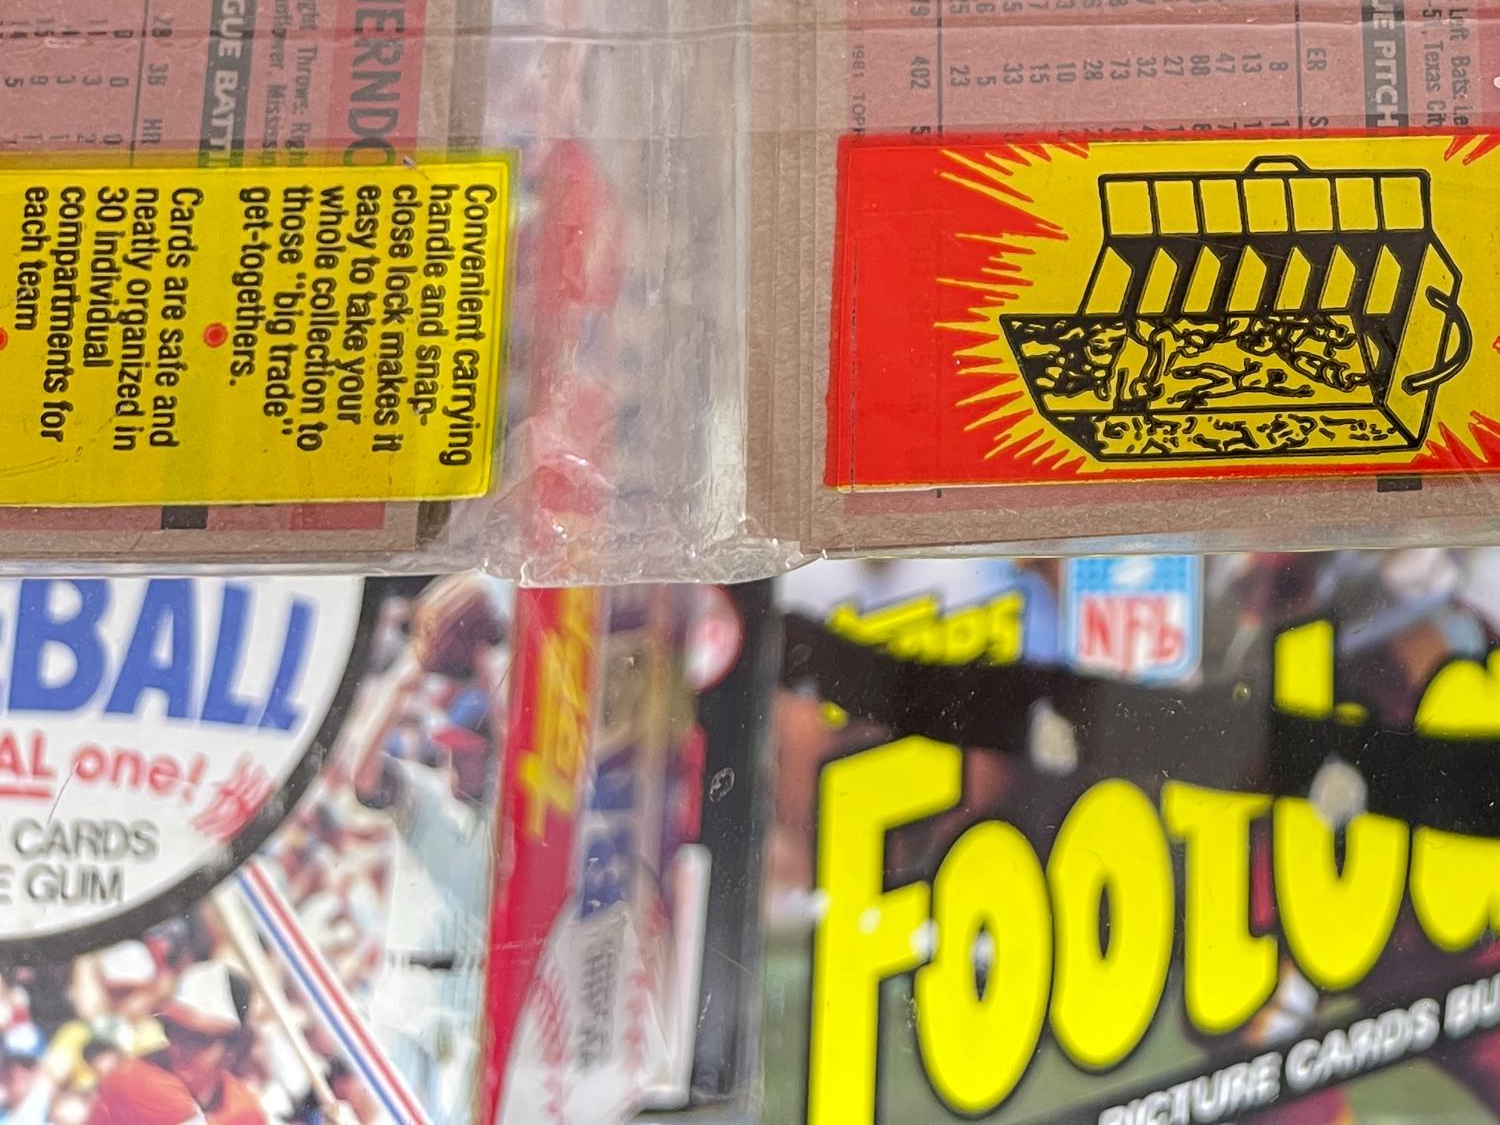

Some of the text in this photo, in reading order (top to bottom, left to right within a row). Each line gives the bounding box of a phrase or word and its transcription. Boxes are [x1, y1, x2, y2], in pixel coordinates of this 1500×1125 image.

[292, 48, 318, 114] Throws:
[950, 66, 970, 88] 23
[1003, 63, 1024, 85] 33
[1029, 63, 1048, 84] 15
[1110, 59, 1130, 81] 73
[1136, 57, 1156, 79] 32
[1216, 53, 1235, 74] 47
[1242, 53, 1261, 73] 13
[1306, 47, 1326, 71] ER
[1373, 40, 1399, 126] PITCH
[1424, 43, 1444, 91] Texas
[1451, 56, 1471, 99] Bats:
[15, 187, 51, 330] each team
[278, 186, 313, 264] those
[39, 186, 87, 442] compartments for
[83, 187, 129, 367] 30 individual
[229, 187, 273, 386] get-togethers.
[334, 185, 382, 424] easy to take your
[408, 184, 458, 426] handle and snap-
[113, 188, 162, 450] neatly organized in
[150, 188, 204, 447] Cards are safe and
[297, 186, 348, 451] whole collection to
[372, 185, 420, 452] close lock makes it
[440, 184, 497, 466] Convenient carrying
[1078, 593, 1184, 672] NFL
[72, 741, 209, 800] one!
[12, 817, 159, 861] CARDS
[26, 865, 124, 903] GUM
[1285, 996, 1441, 1091] CARDS
